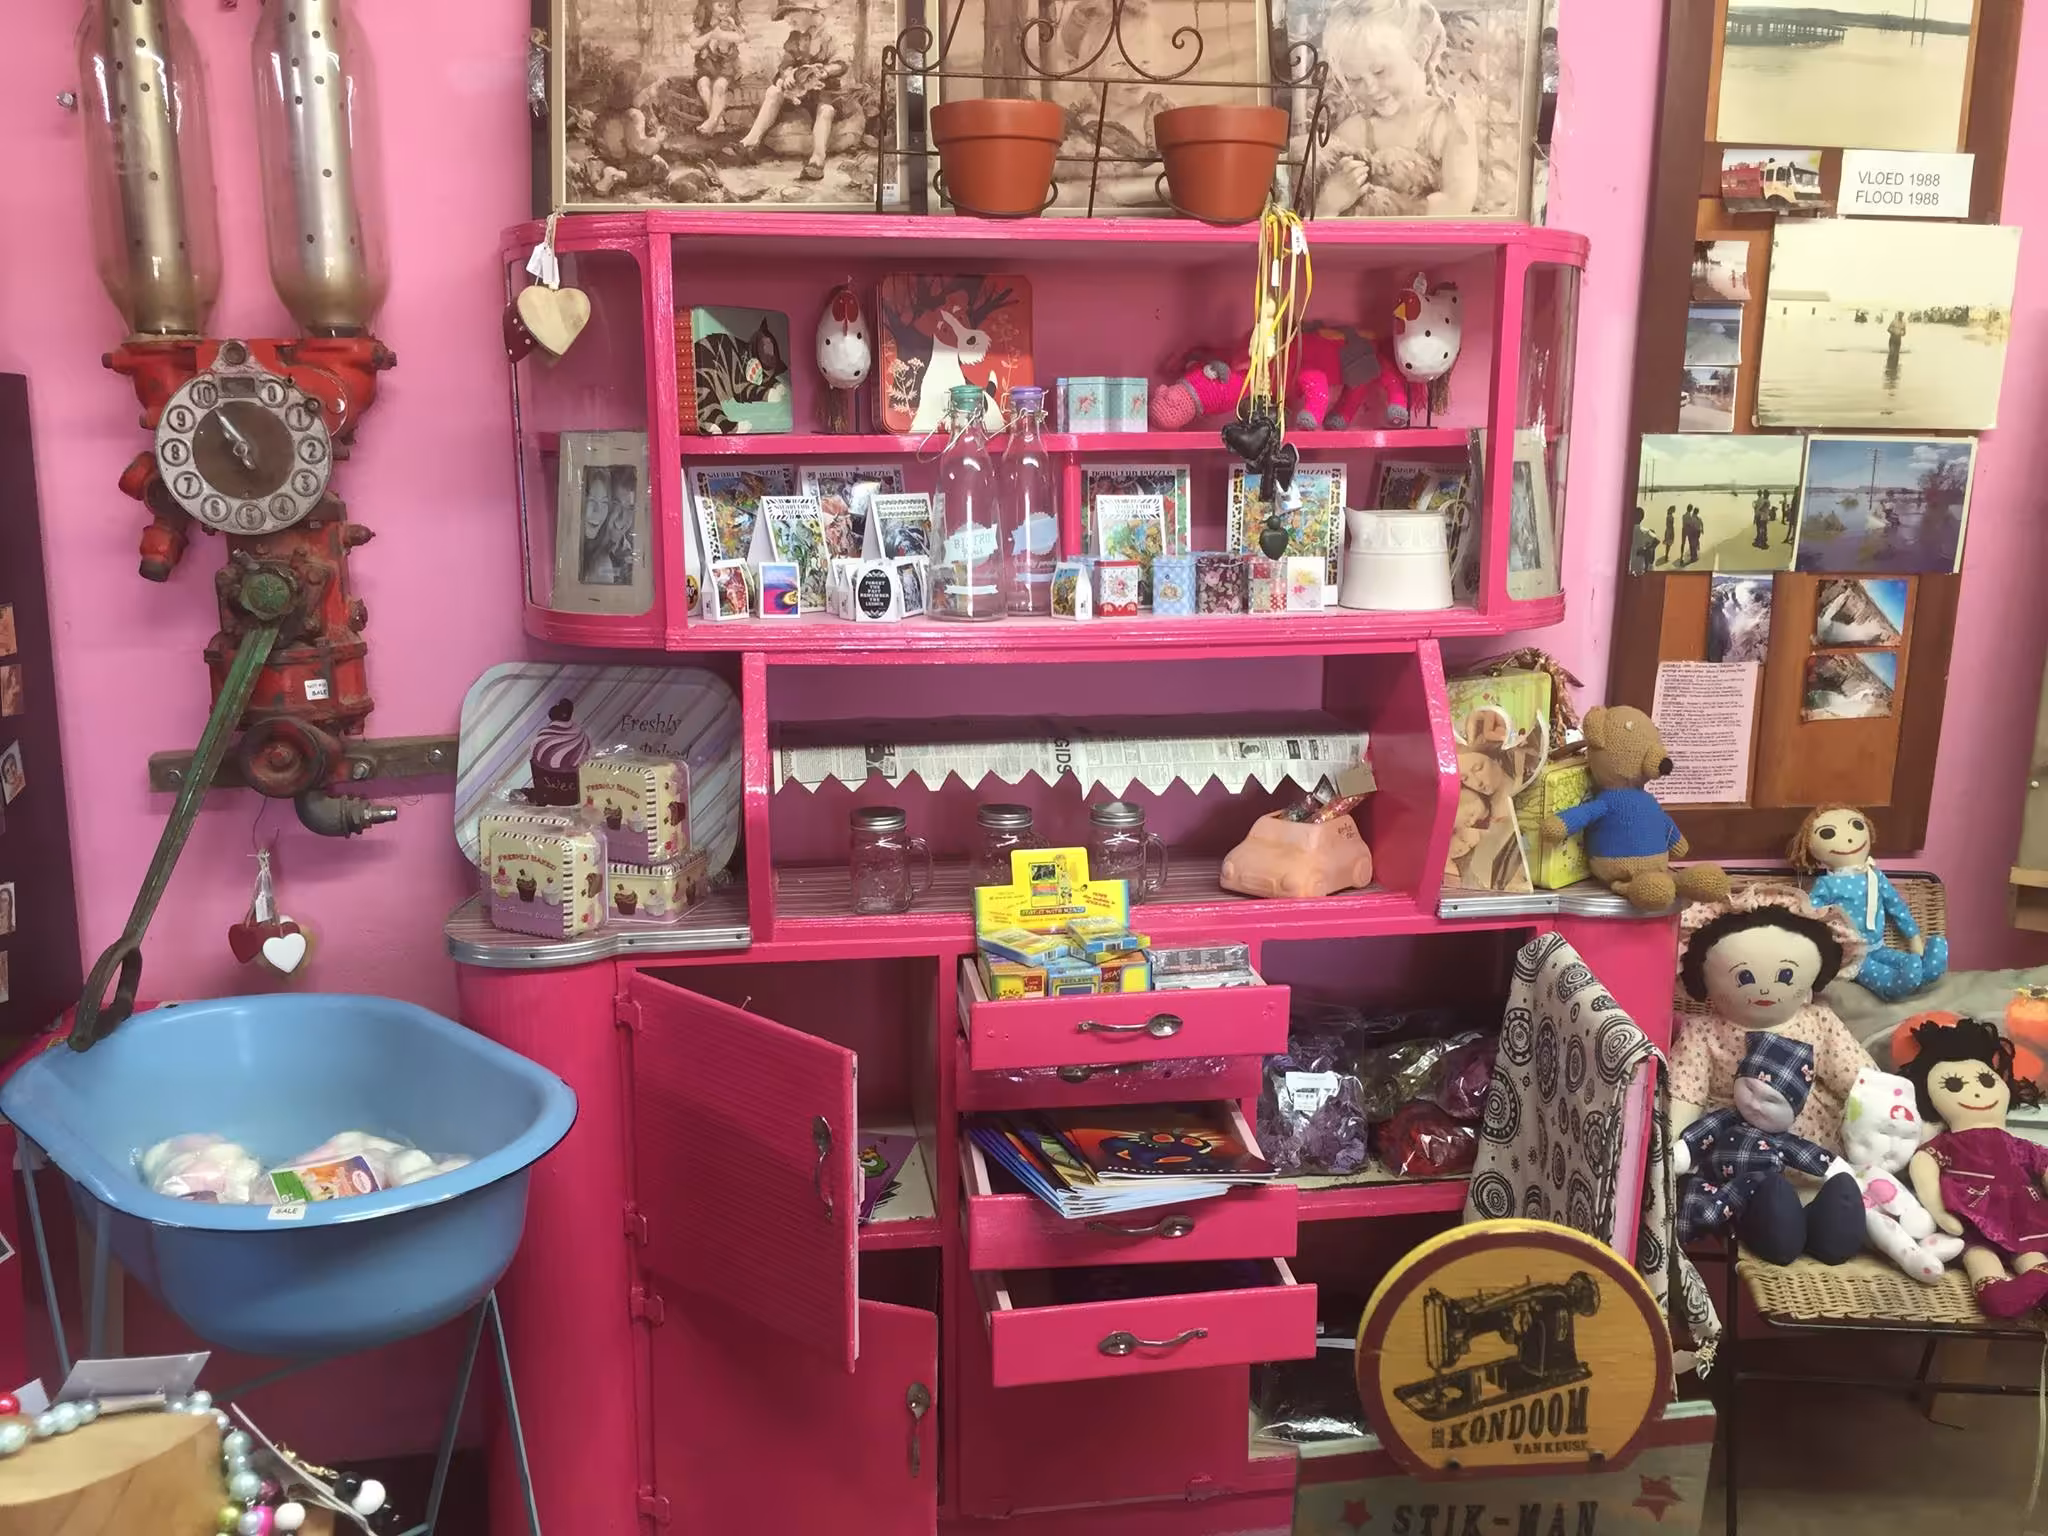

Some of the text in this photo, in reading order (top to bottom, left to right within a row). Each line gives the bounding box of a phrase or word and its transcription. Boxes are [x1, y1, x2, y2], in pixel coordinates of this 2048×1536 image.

[1858, 171, 1940, 187] VLOED 1988
[1855, 190, 1939, 206] FLOOD 1988
[620, 713, 682, 736] Freshly
[274, 1207, 298, 1215] SALE
[1448, 1386, 1590, 1449] KONDOOM
[1513, 1442, 1543, 1455] VAN
